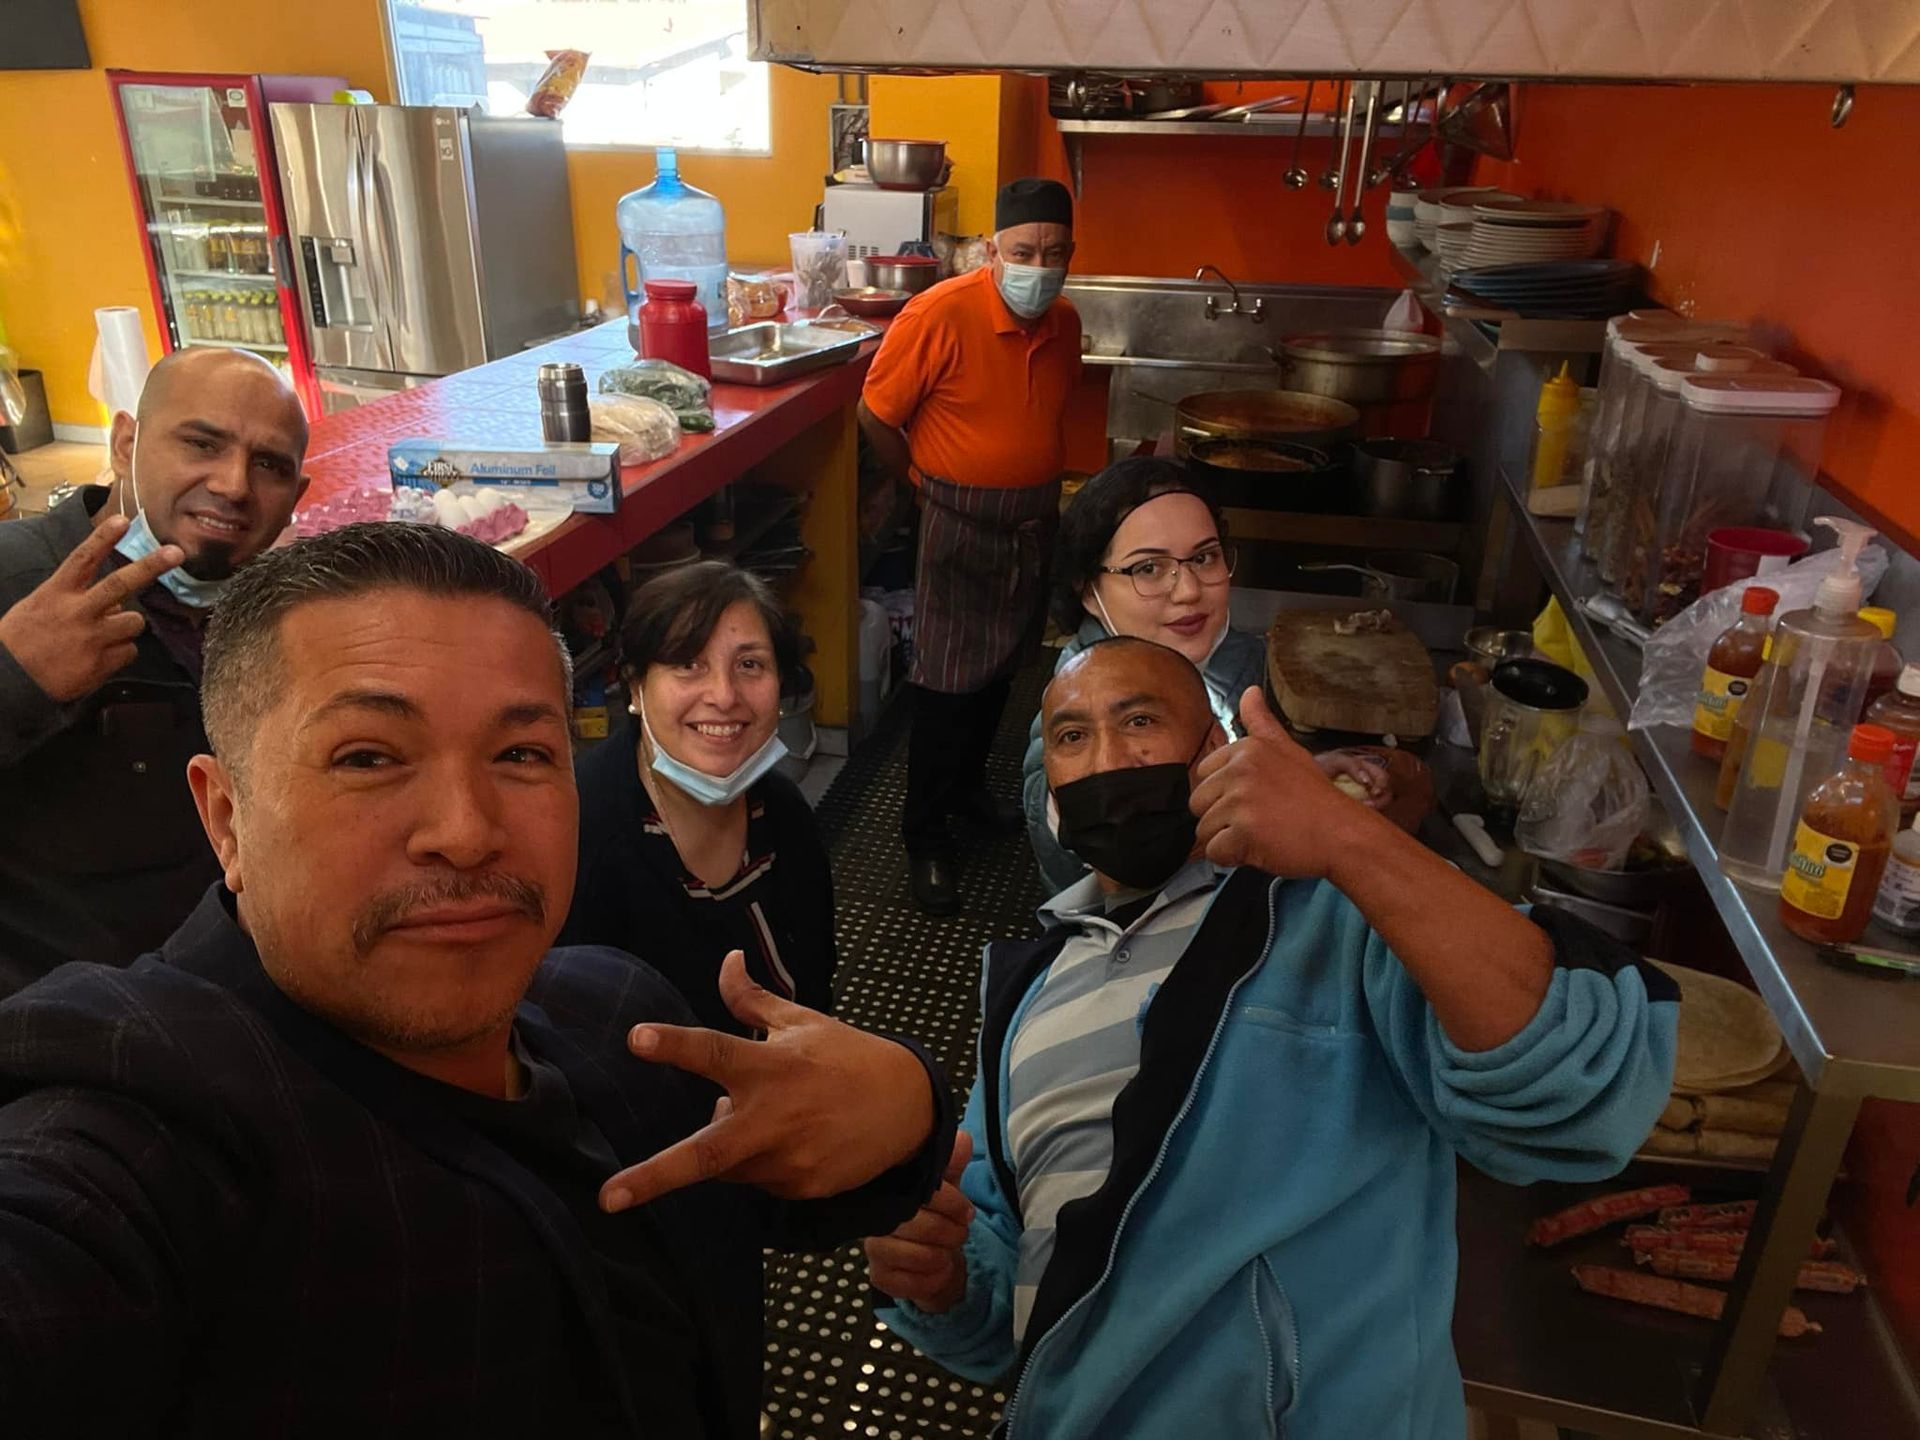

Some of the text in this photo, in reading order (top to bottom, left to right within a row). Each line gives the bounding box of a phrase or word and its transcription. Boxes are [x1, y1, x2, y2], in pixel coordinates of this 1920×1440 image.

[428, 461, 453, 472] FIRST
[470, 463, 556, 475] Aluminum Foil
